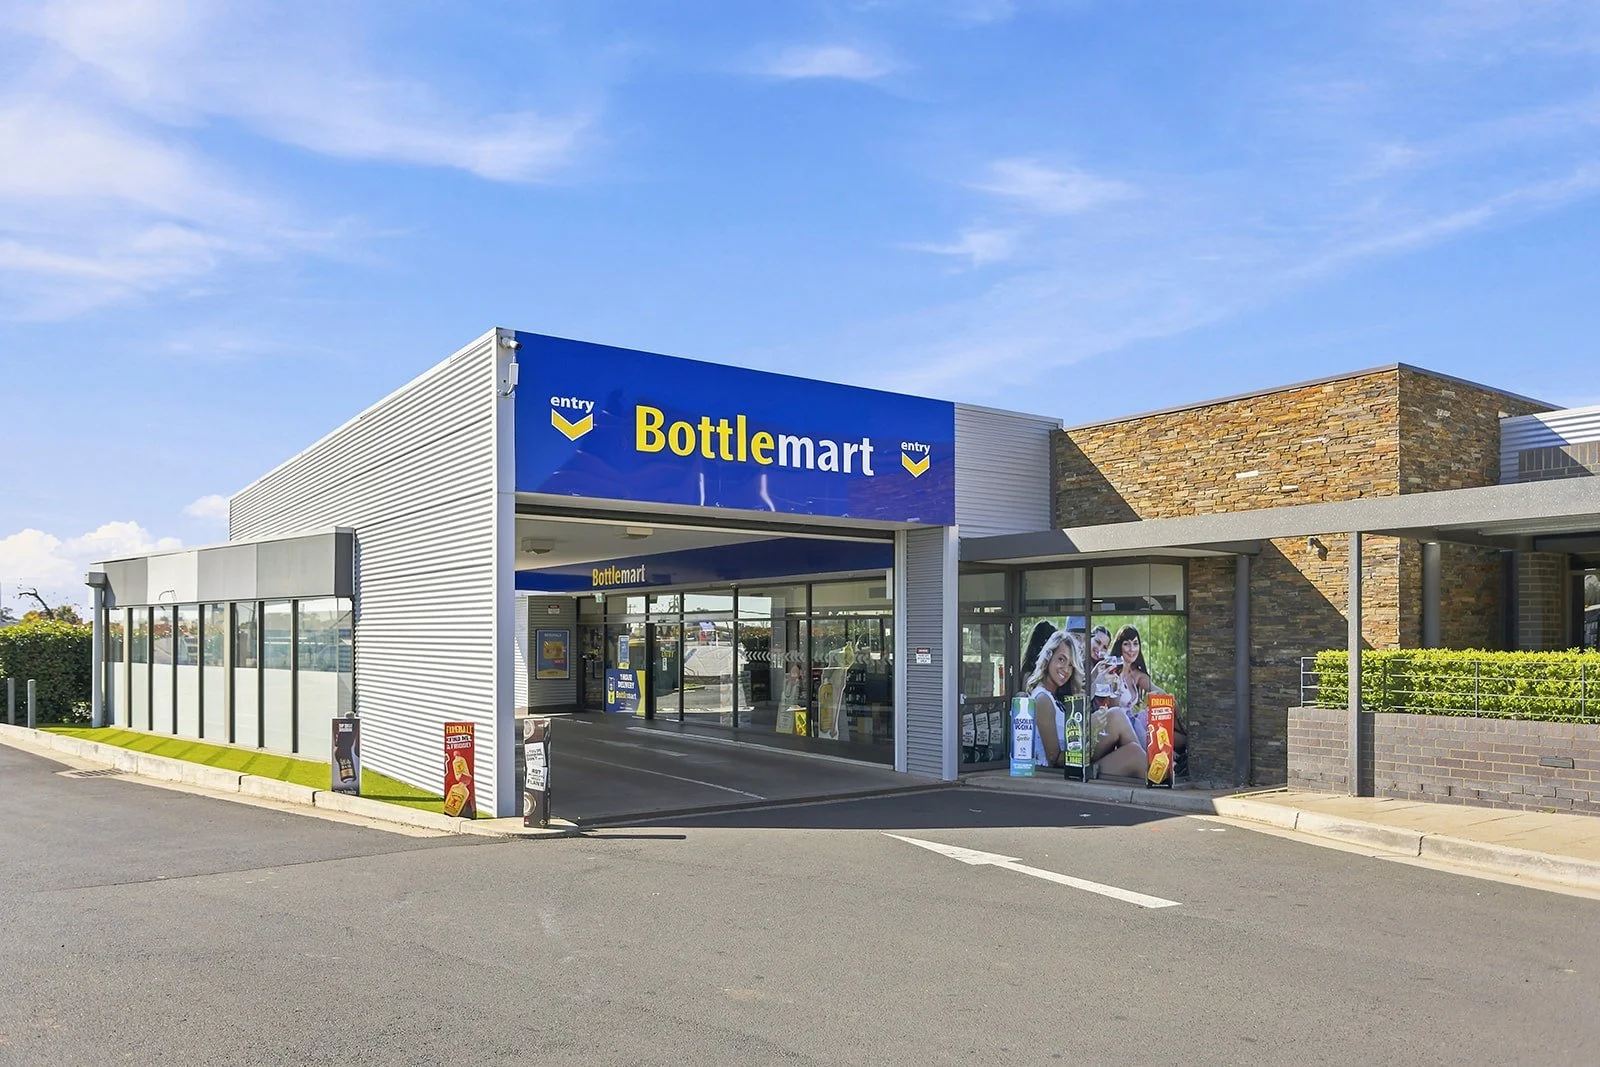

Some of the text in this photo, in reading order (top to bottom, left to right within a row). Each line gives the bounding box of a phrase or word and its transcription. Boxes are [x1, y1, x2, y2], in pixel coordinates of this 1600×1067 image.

[550, 396, 595, 414] entry
[635, 404, 875, 477] Bottlemart
[900, 441, 931, 456] entry
[592, 564, 646, 586] Bottlemart
[446, 725, 473, 735] FIREBALL
